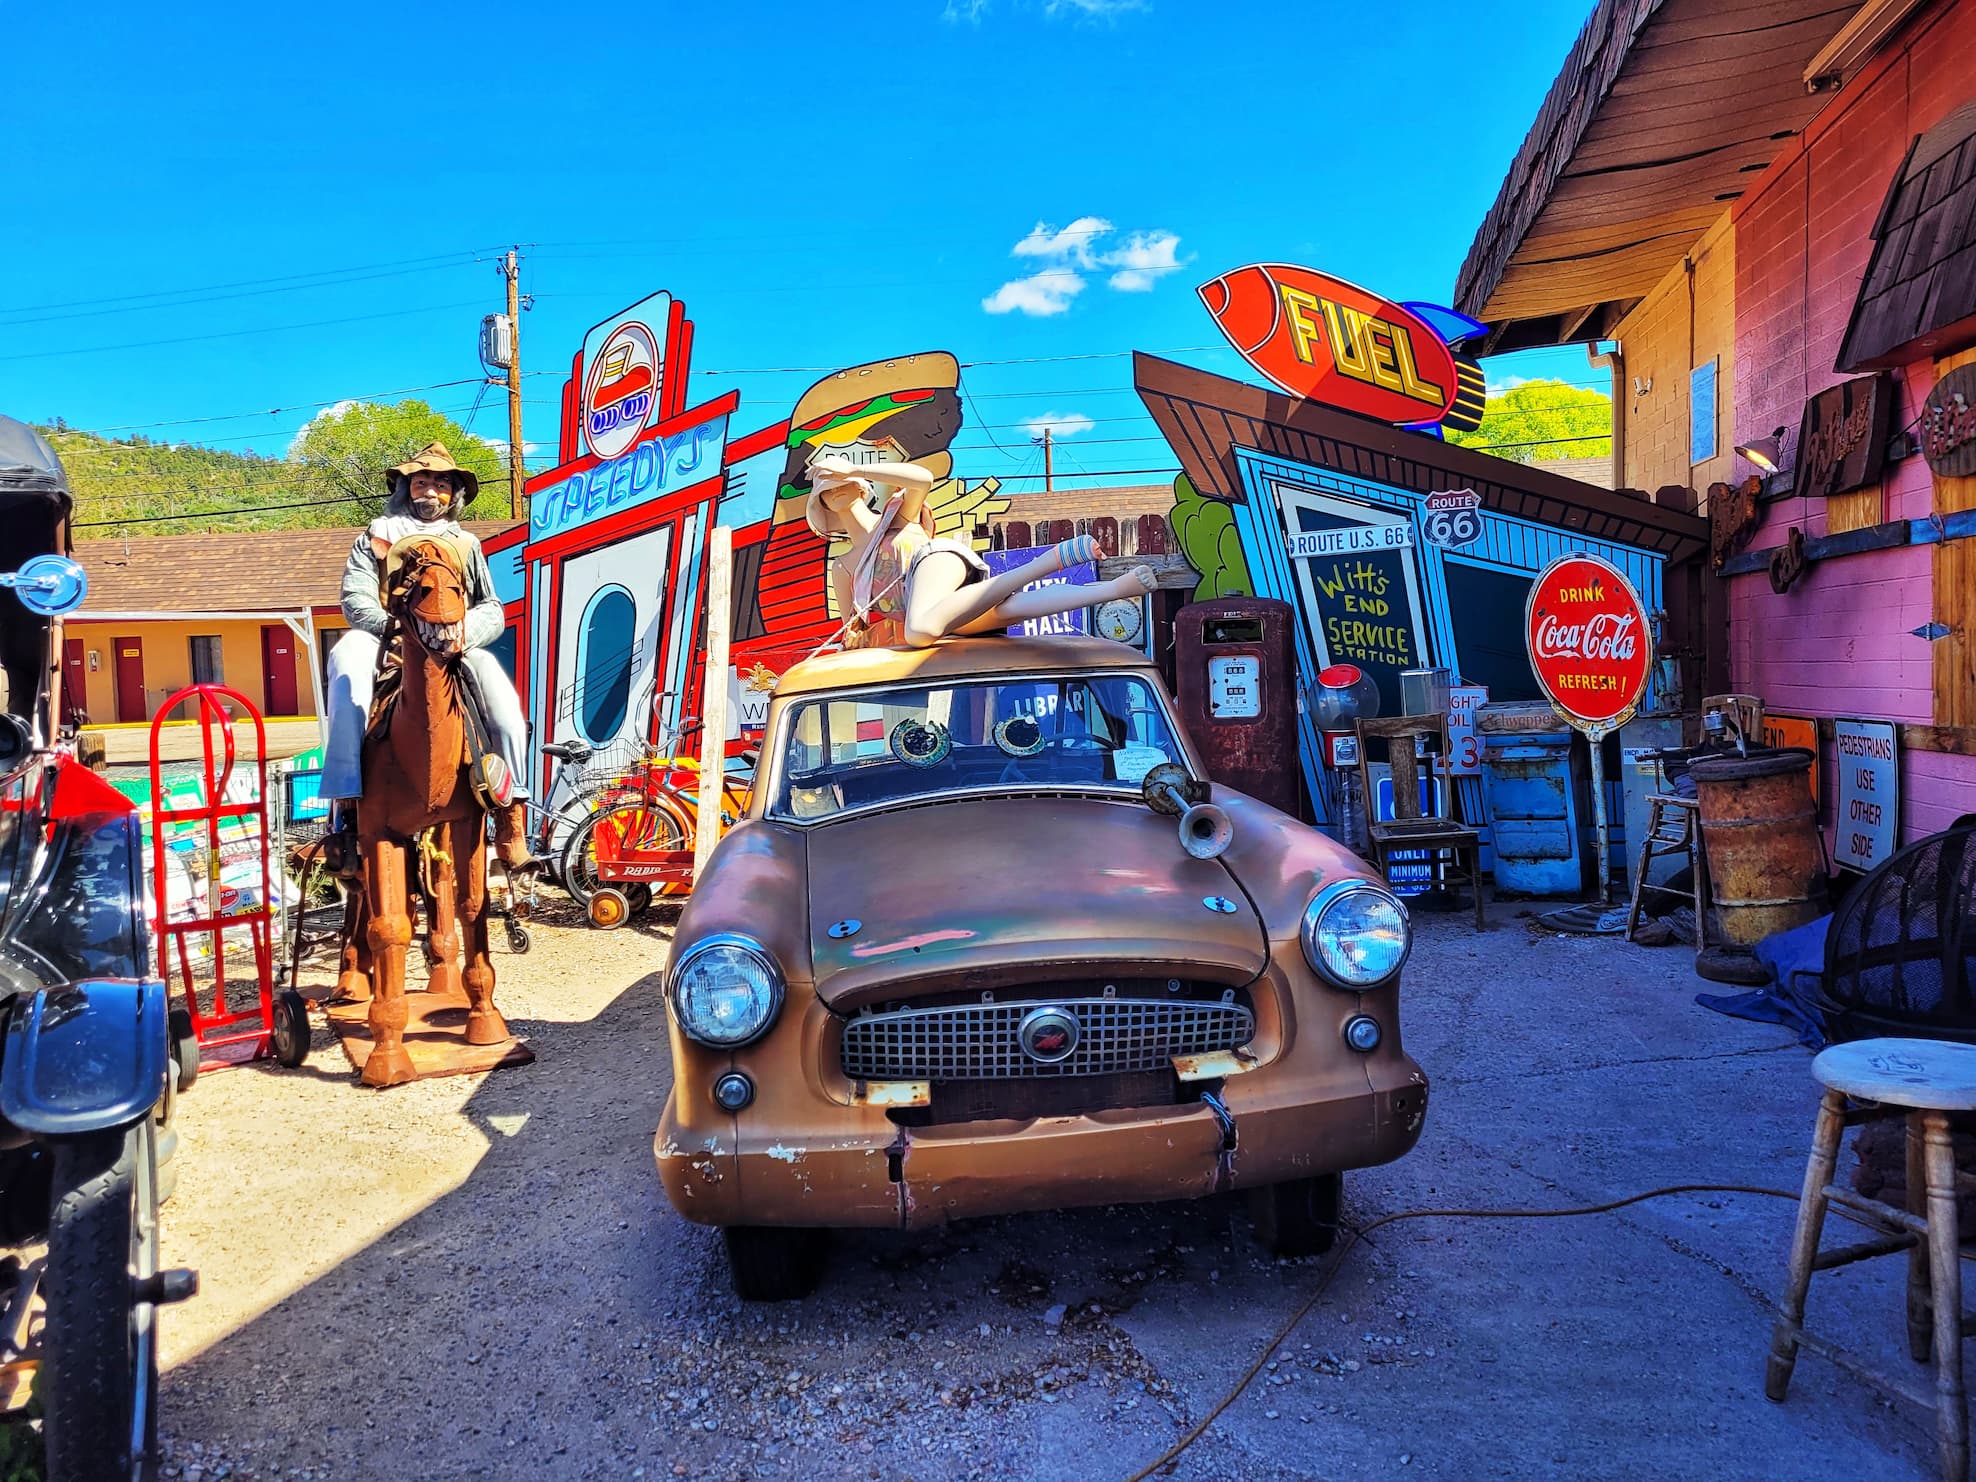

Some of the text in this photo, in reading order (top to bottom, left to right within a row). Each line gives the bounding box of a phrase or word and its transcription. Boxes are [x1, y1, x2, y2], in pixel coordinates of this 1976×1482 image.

[1277, 283, 1445, 407] FUEL
[825, 450, 887, 465] OUTE
[533, 423, 712, 530] SPEEDYS
[1431, 495, 1473, 509] ROUTE
[1431, 511, 1474, 540] 66
[1298, 527, 1404, 554] ROUTE U.S. 66
[1344, 595, 1389, 616] END
[1560, 586, 1605, 603] DRINK
[1023, 611, 1074, 637] HALL
[1328, 617, 1409, 653] SERVICE
[1535, 612, 1638, 660] Coca-Cola
[1333, 644, 1409, 665] STATION
[1014, 690, 1087, 720] LIBRAR
[1838, 734, 1892, 761] PEDESTRIANS
[1855, 767, 1876, 791] USE
[1850, 799, 1882, 827] OTHER
[1851, 832, 1874, 859] SIDE
[1391, 864, 1432, 877] MINIMUM
